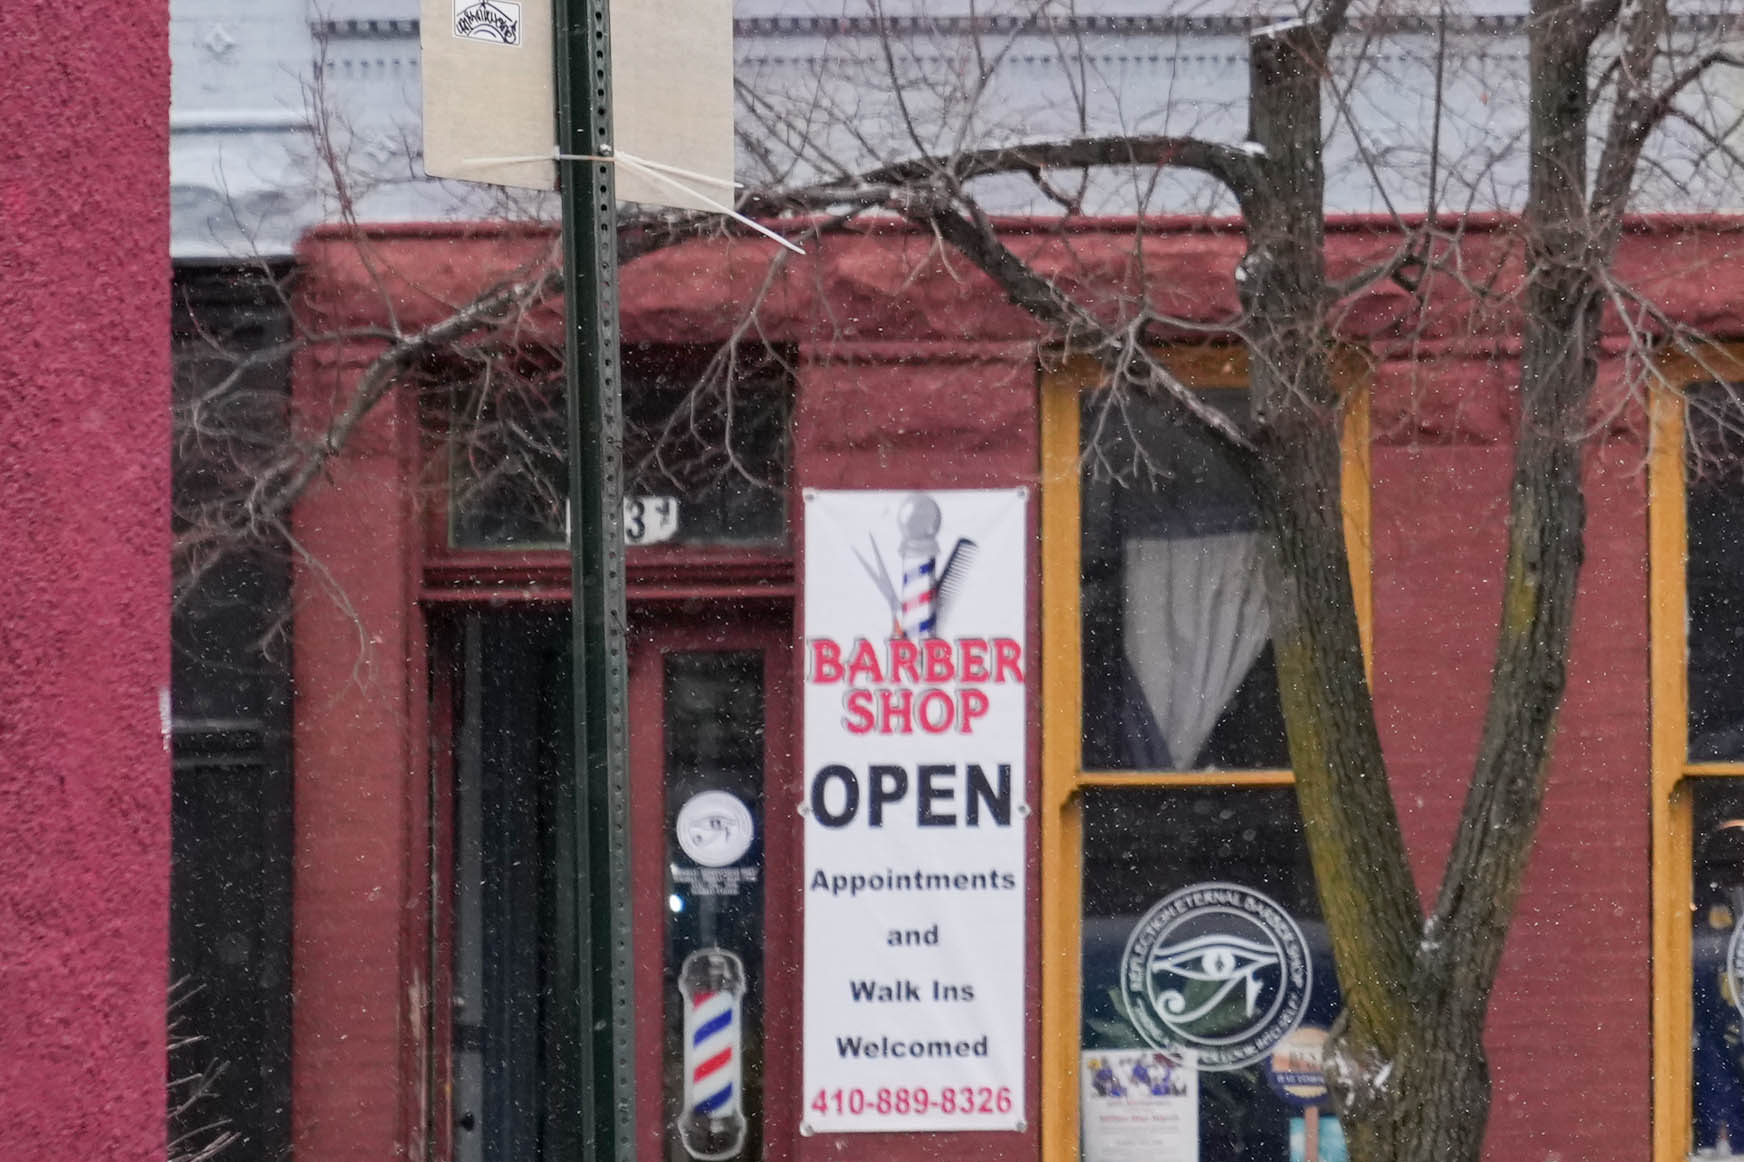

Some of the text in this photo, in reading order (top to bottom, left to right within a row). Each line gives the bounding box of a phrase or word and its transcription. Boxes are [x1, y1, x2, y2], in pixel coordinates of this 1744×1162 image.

[809, 638, 1025, 685] BARBER
[843, 689, 990, 734] SHOP
[811, 764, 1012, 828] OPEN
[811, 869, 1016, 897] Appointments
[887, 924, 938, 947] and
[850, 980, 975, 1002] Walk Ins
[836, 1035, 989, 1058] Welcomed
[811, 1087, 1013, 1115] 410-889-8326
